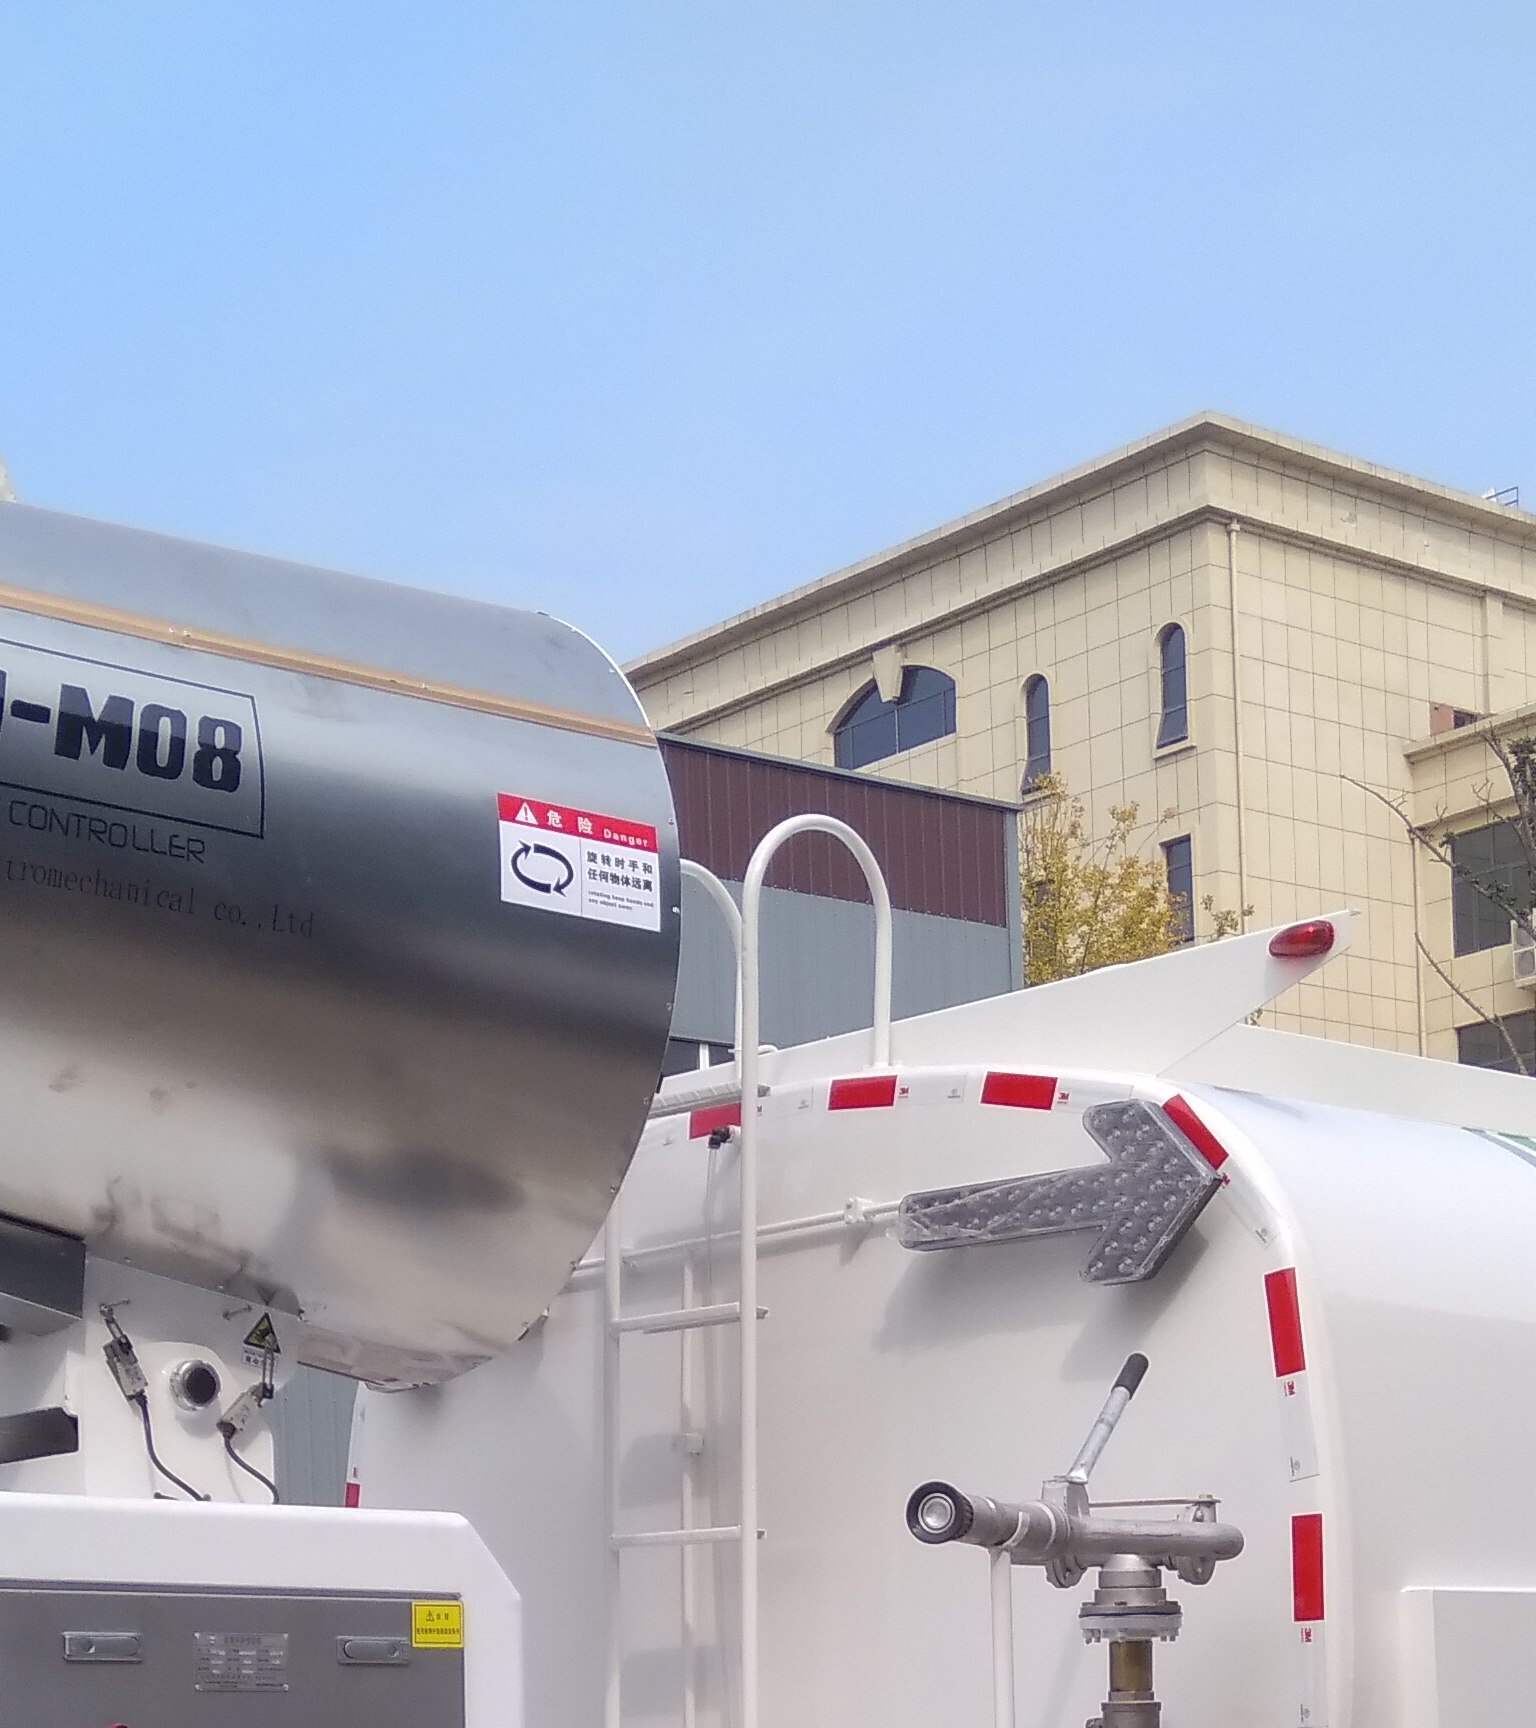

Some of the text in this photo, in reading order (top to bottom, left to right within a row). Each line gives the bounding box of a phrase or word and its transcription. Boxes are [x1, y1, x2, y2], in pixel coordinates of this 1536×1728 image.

[9, 800, 206, 863] CONTROLLER
[547, 810, 649, 847] 危险 Danger
[587, 868, 653, 892] 任何物体远离
